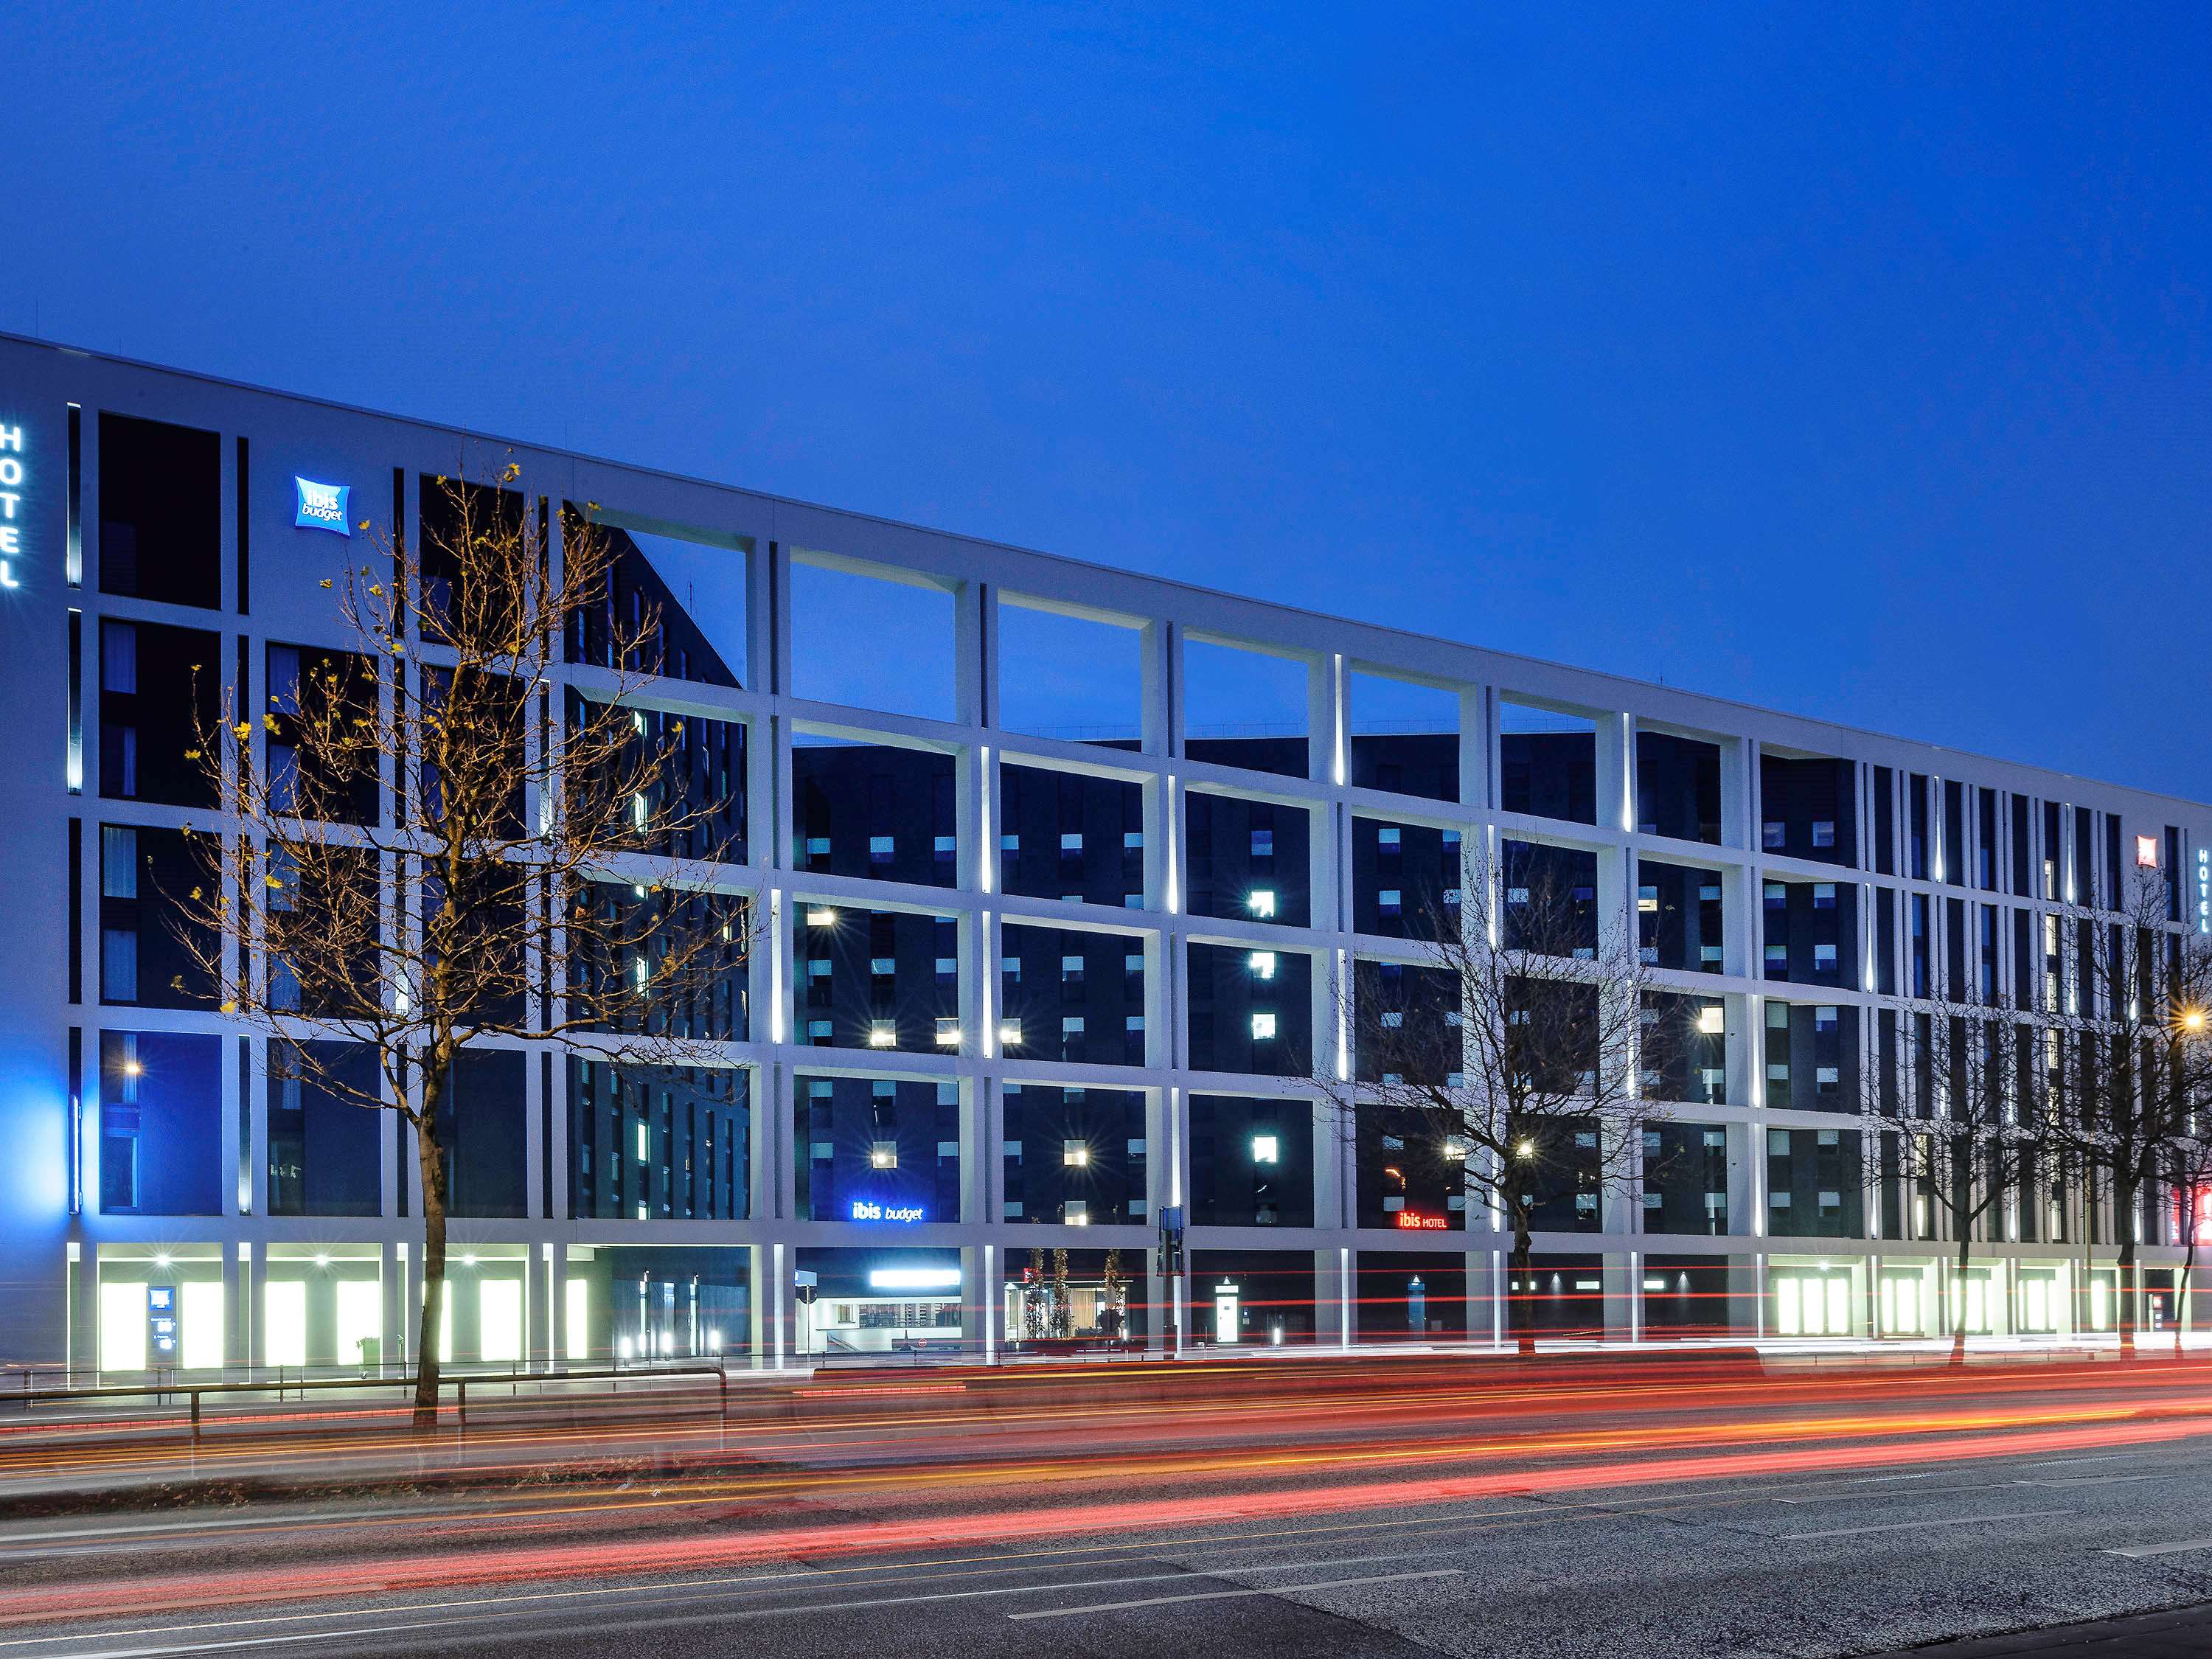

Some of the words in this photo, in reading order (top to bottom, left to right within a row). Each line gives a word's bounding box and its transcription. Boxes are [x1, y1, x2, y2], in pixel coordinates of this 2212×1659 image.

[0, 424, 22, 588] HOTEL
[307, 489, 338, 510] ibis
[302, 502, 343, 521] budget
[2199, 849, 2209, 933] HOTEL
[852, 1202, 881, 1220] ibis
[885, 1206, 923, 1222] budget
[1399, 1212, 1421, 1228] ibis
[1422, 1218, 1447, 1228] HOTEL
